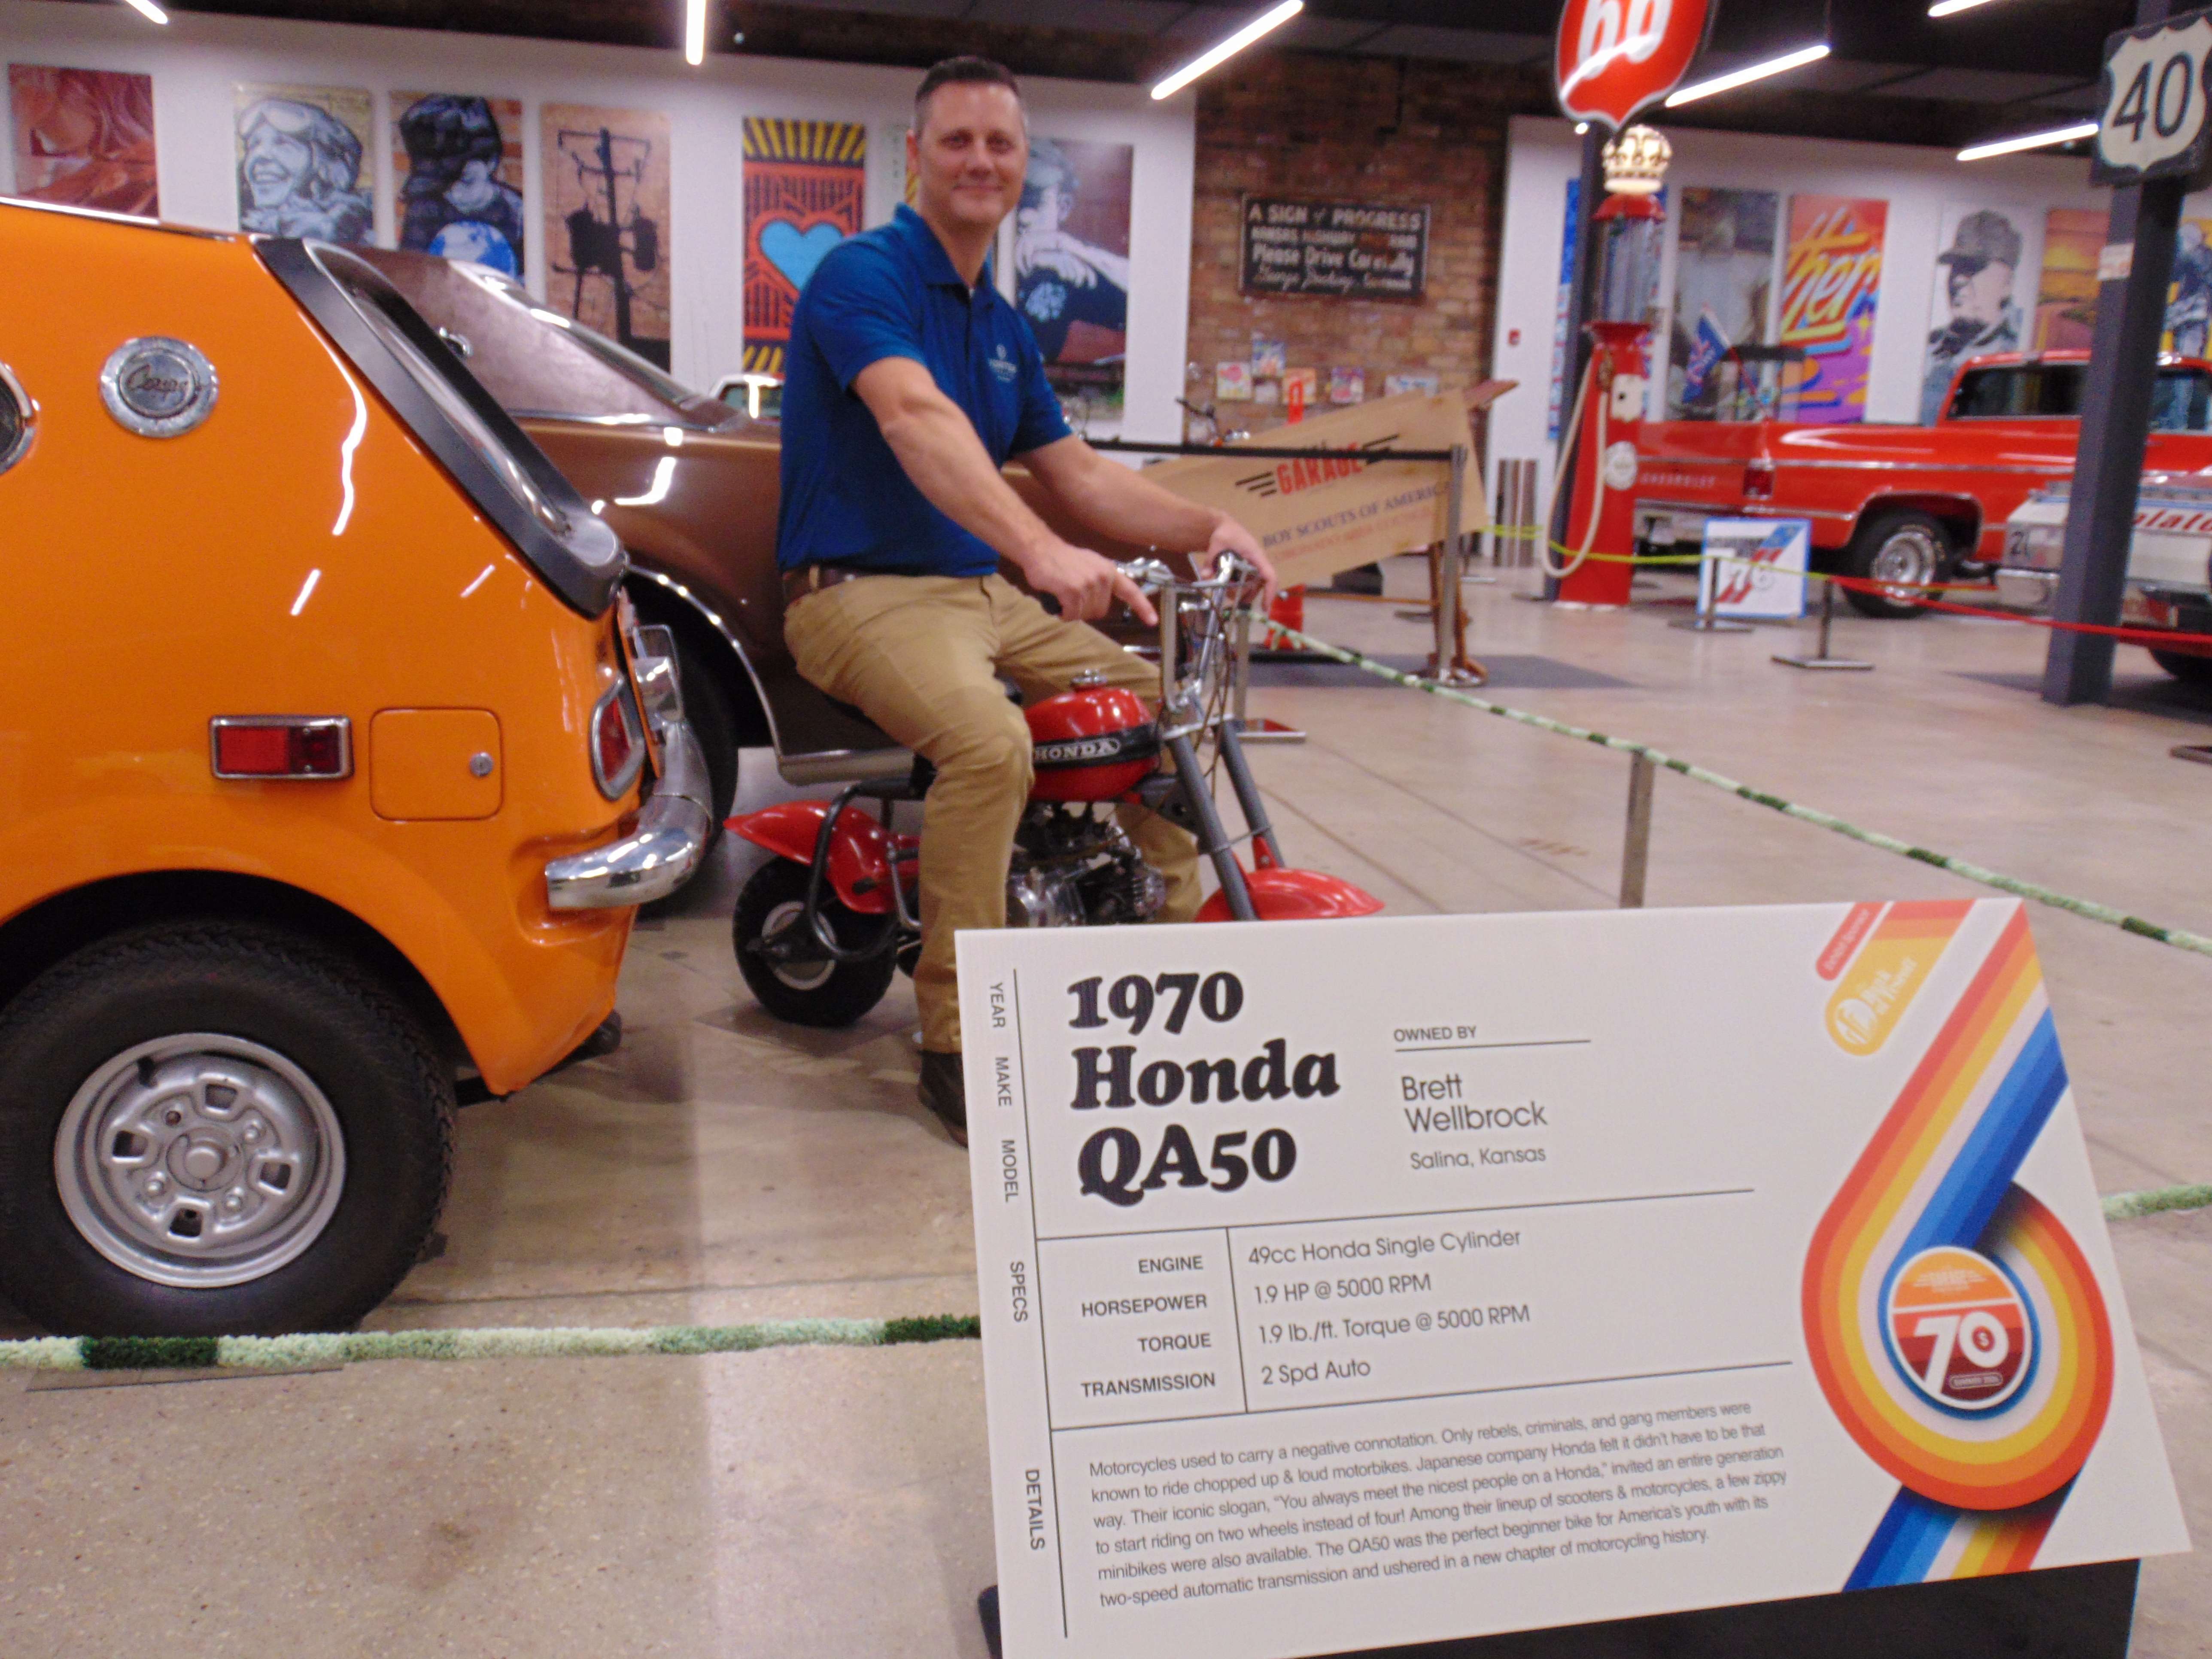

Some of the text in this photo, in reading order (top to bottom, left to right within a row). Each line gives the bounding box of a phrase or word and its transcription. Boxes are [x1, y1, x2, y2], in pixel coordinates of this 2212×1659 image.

[2111, 52, 2194, 142] 40
[1249, 203, 1263, 222] A
[1267, 203, 1308, 224] SIGN
[1333, 208, 1422, 231] PROGRESS
[1252, 243, 1300, 265] Please
[1305, 246, 1344, 269] Drive
[1263, 528, 1294, 548] BOY
[1296, 508, 1362, 537] SCOUTS
[1359, 500, 1379, 518] OF
[990, 982, 1006, 1028] YEAR
[1068, 971, 1243, 1035] 1970
[1394, 1025, 1477, 1042] OWNED BY
[995, 1056, 1012, 1107] MAKE
[1070, 1038, 1340, 1110] Honda
[1401, 1074, 1462, 1101] Brett
[1404, 1101, 1548, 1133] Wellbrock
[1001, 1139, 1018, 1203] MODEL
[1078, 1124, 1297, 1206] QA50
[1410, 1148, 1546, 1170] Salina, Kansas
[1138, 1255, 1203, 1274] ENGINE
[1249, 1231, 1520, 1264] 49cc Honda Single Cylinder
[1010, 1261, 1028, 1323] SPECS
[1082, 1294, 1207, 1317] HORSEPOWER
[1255, 1273, 1432, 1304] 1.9 HP @ 5000 RPM
[1137, 1333, 1212, 1352] TORQUE
[1260, 1304, 1530, 1343] 1.9 lb./ft. Torque @ 5000 RPM
[1262, 1359, 1371, 1386] 2 Spd Auto
[1914, 1311, 2010, 1394] 70
[1081, 1373, 1215, 1398] TRANSMISSION
[1090, 1403, 1751, 1477] Motorcycles used to carry a negative connotation. Only rebels, criminals, and gang members were
[1092, 1488, 1139, 1502] known
[1145, 1485, 1157, 1497] to
[1163, 1481, 1188, 1495] ride
[1194, 1474, 1256, 1493] chopped
[1261, 1474, 1279, 1489] up
[1283, 1470, 1293, 1483] &
[1298, 1466, 1328, 1482] loud
[1333, 1459, 1412, 1479] motorbikes.
[1416, 1452, 1483, 1472] Japanese
[1487, 1446, 1547, 1462] company
[1552, 1440, 1595, 1456] Honda
[1599, 1437, 1618, 1452] felt
[1623, 1436, 1630, 1449] it
[1671, 1431, 1703, 1444] have
[1705, 1429, 1717, 1441] to
[1721, 1426, 1738, 1440] be
[1741, 1424, 1765, 1438] that
[1025, 1468, 1045, 1551] DETAILS
[1094, 1516, 1126, 1530] way.
[1131, 1508, 1167, 1524] Their
[1173, 1504, 1214, 1520] iconic
[1219, 1500, 1270, 1517] slogan,
[1312, 1491, 1359, 1507] always
[1364, 1486, 1399, 1501] meet
[1403, 1483, 1424, 1497] the
[1428, 1478, 1468, 1495] nicest
[1472, 1473, 1518, 1493] people
[1522, 1472, 1539, 1485] on
[1544, 1471, 1552, 1483] a
[1611, 1458, 1653, 1475] invited
[1657, 1458, 1674, 1471] an
[1677, 1452, 1713, 1468] entire
[1716, 1446, 1784, 1468] generation
[1096, 1541, 1109, 1554] to
[1115, 1536, 1146, 1553] start
[1152, 1532, 1191, 1550] riding
[1196, 1531, 1213, 1544] on
[1218, 1528, 1243, 1541] two
[1248, 1520, 1298, 1538] wheels
[1303, 1515, 1353, 1533] instead
[1357, 1512, 1371, 1527] of
[1375, 1508, 1405, 1525] four!
[1410, 1505, 1459, 1521] Among
[1463, 1501, 1492, 1516] their
[1496, 1496, 1537, 1512] lineup
[1540, 1493, 1553, 1508] of
[1557, 1489, 1613, 1506] scooters
[1617, 1485, 1627, 1499] &
[1715, 1477, 1725, 1489] a
[1727, 1473, 1750, 1487] few
[1754, 1470, 1787, 1487] zippy
[1098, 1562, 1166, 1580] minibikes
[1171, 1559, 1206, 1572] were
[1212, 1554, 1241, 1569] also
[1246, 1545, 1311, 1565] available.
[1316, 1542, 1344, 1557] The
[1348, 1536, 1389, 1554] QA50
[1393, 1535, 1422, 1549] was
[1426, 1531, 1447, 1546] the
[1452, 1524, 1499, 1545] perfect
[1502, 1518, 1561, 1539] beginner
[1565, 1514, 1593, 1530] bike
[1596, 1512, 1613, 1527] for
[1684, 1501, 1721, 1520] youth
[1724, 1497, 1750, 1512] with
[1753, 1495, 1769, 1510] its
[1100, 1528, 1709, 1607] two-speed automatic transmission and ushered in a new chapter of motorcycling history.
